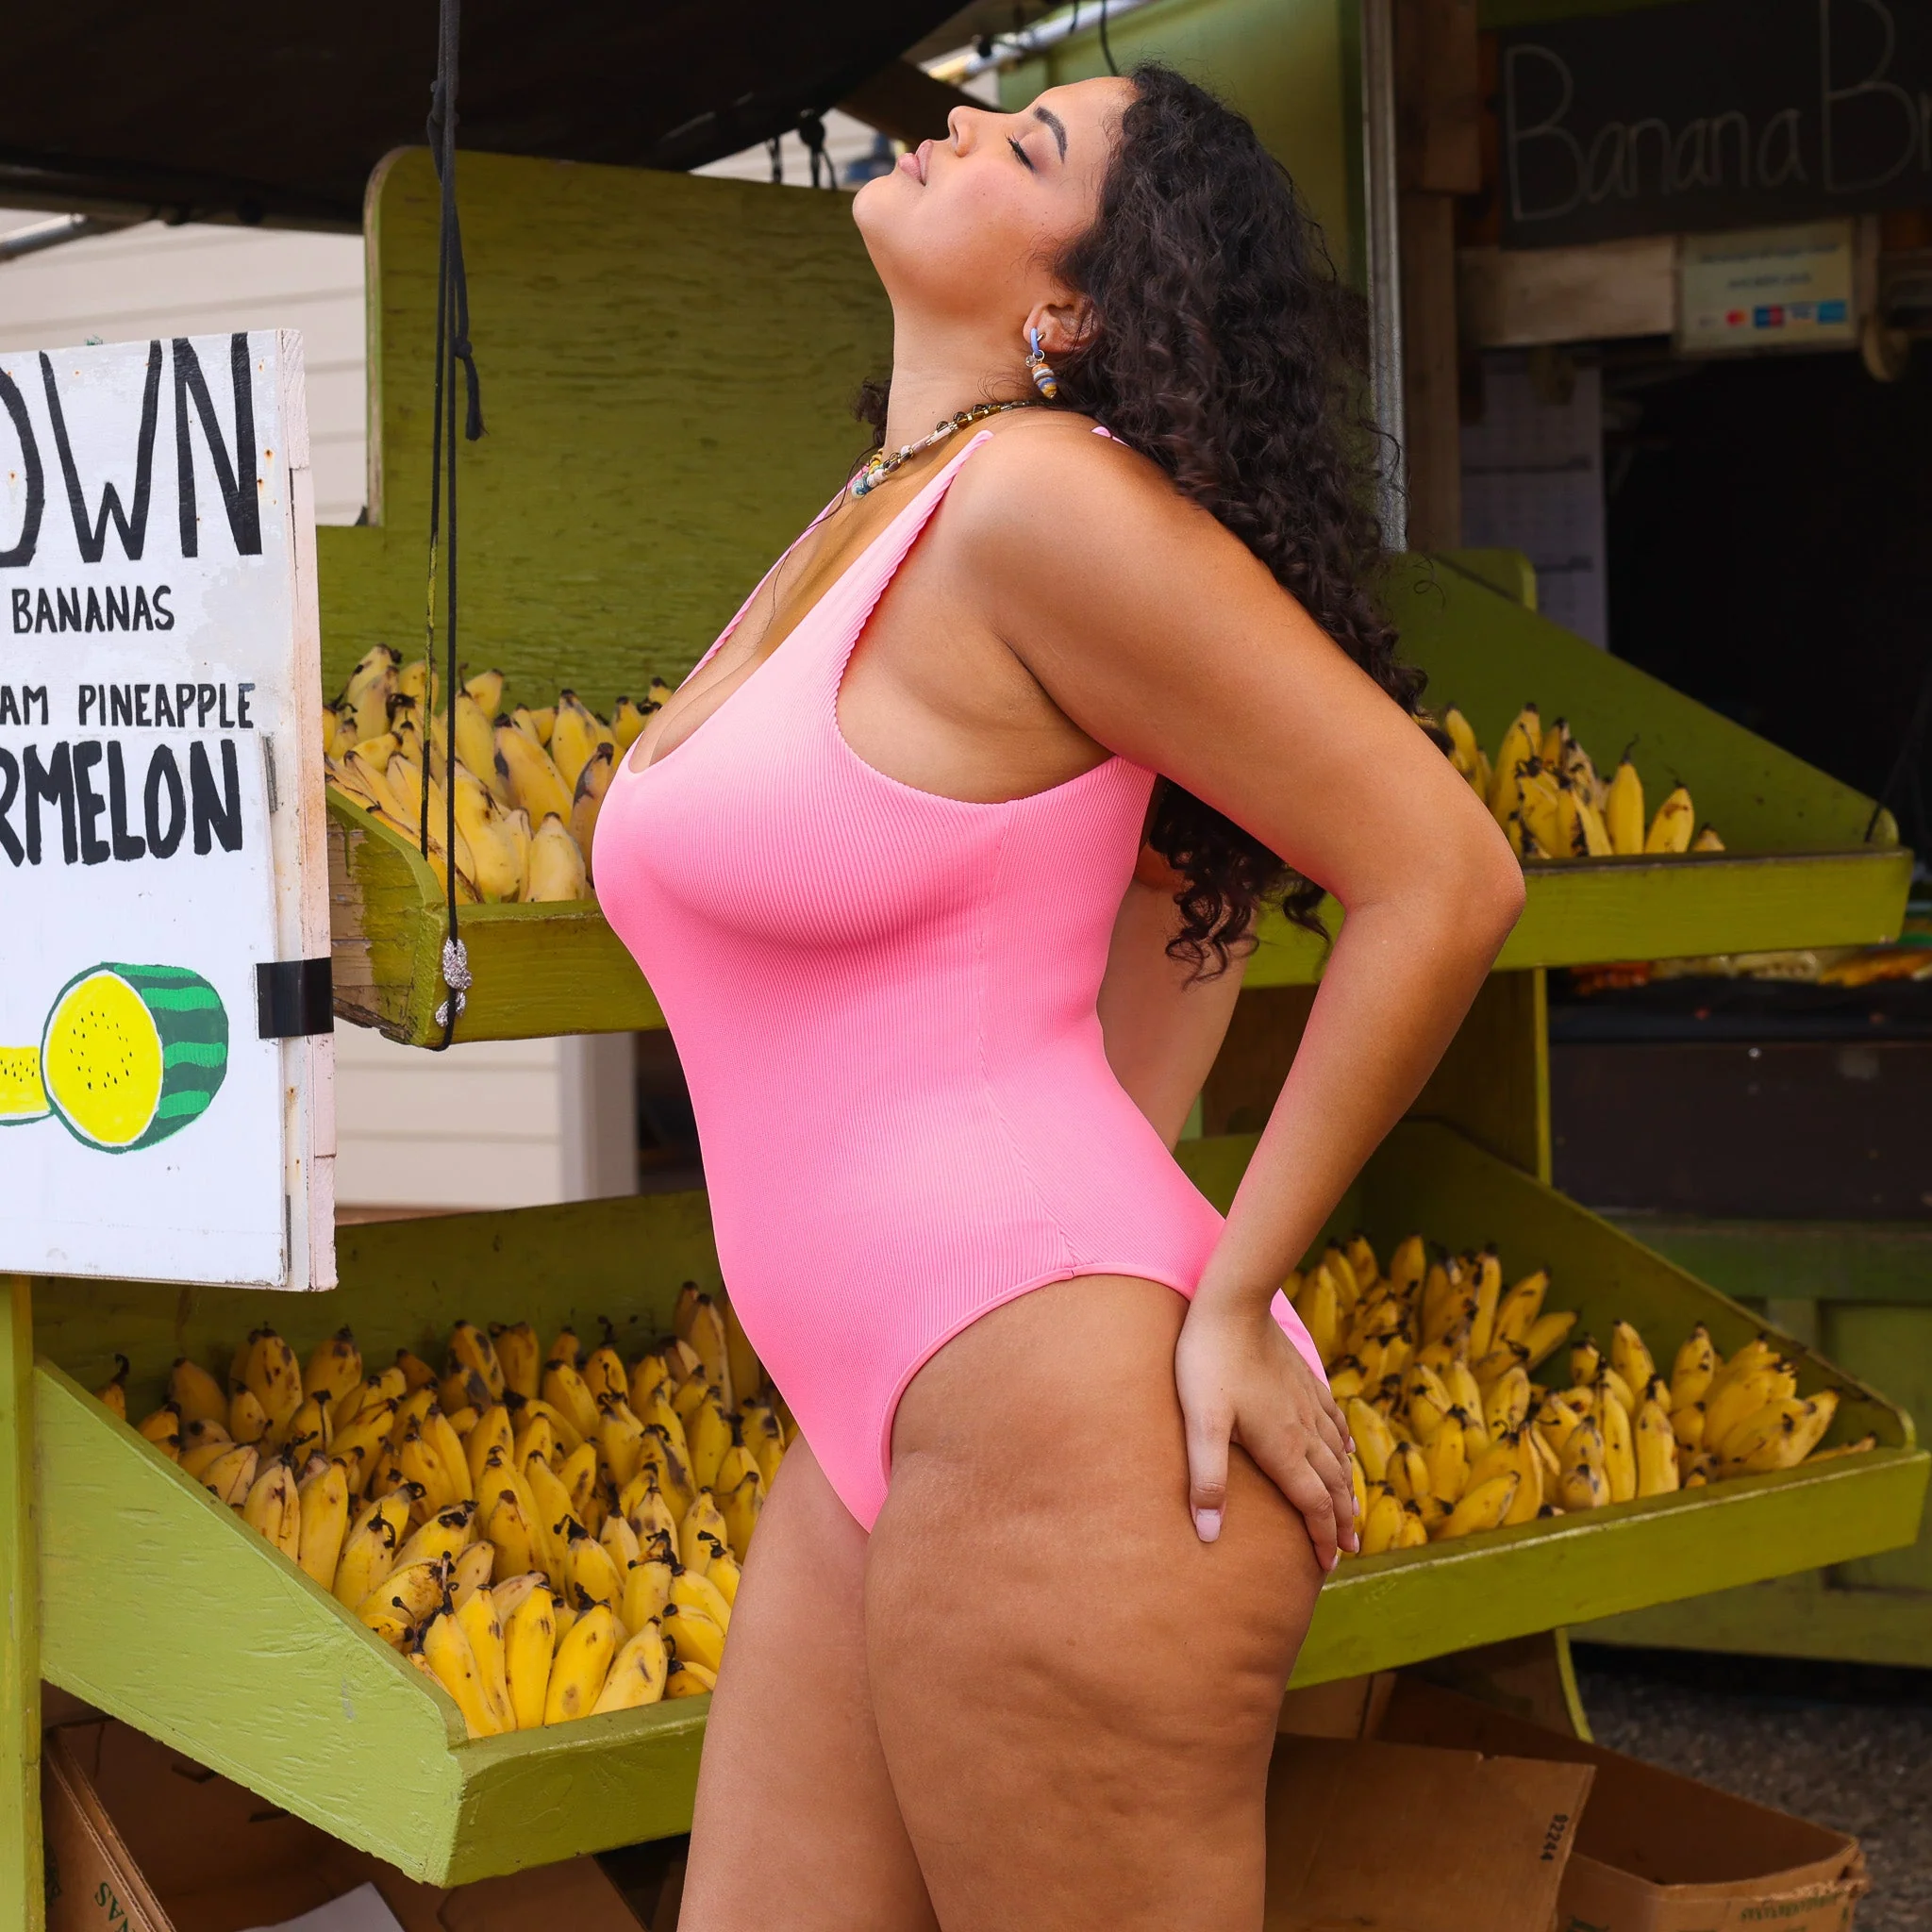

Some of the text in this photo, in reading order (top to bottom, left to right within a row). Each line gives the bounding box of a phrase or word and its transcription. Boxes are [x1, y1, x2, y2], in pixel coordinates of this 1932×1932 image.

[1504, 42, 1809, 222] Banana
[12, 585, 175, 634] BANANAS
[0, 683, 256, 729] AM PINEAPPLE
